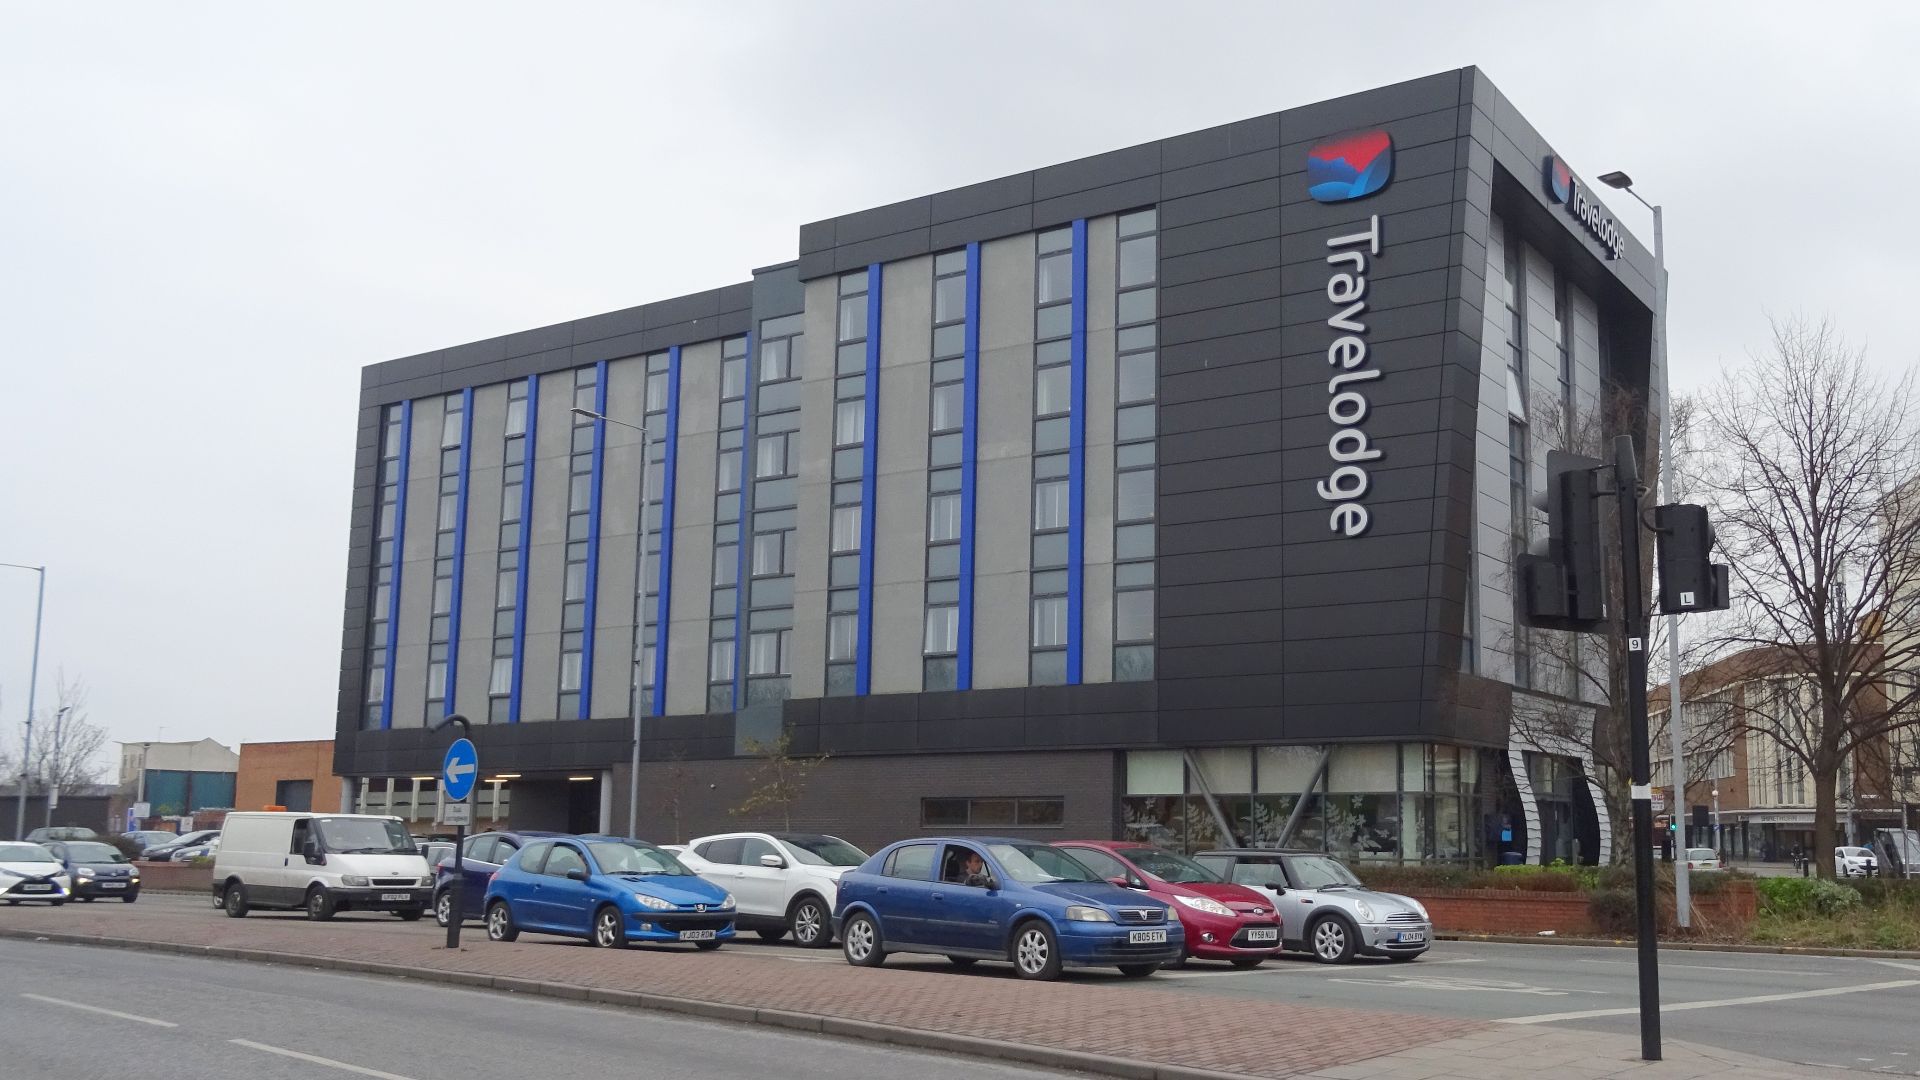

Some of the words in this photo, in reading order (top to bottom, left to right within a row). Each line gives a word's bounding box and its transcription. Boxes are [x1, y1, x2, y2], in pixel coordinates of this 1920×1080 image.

[1571, 176, 1624, 260] Travelodge
[1316, 214, 1382, 536] Travelodge
[1132, 932, 1150, 942] KB05
[1151, 931, 1164, 941] ETK
